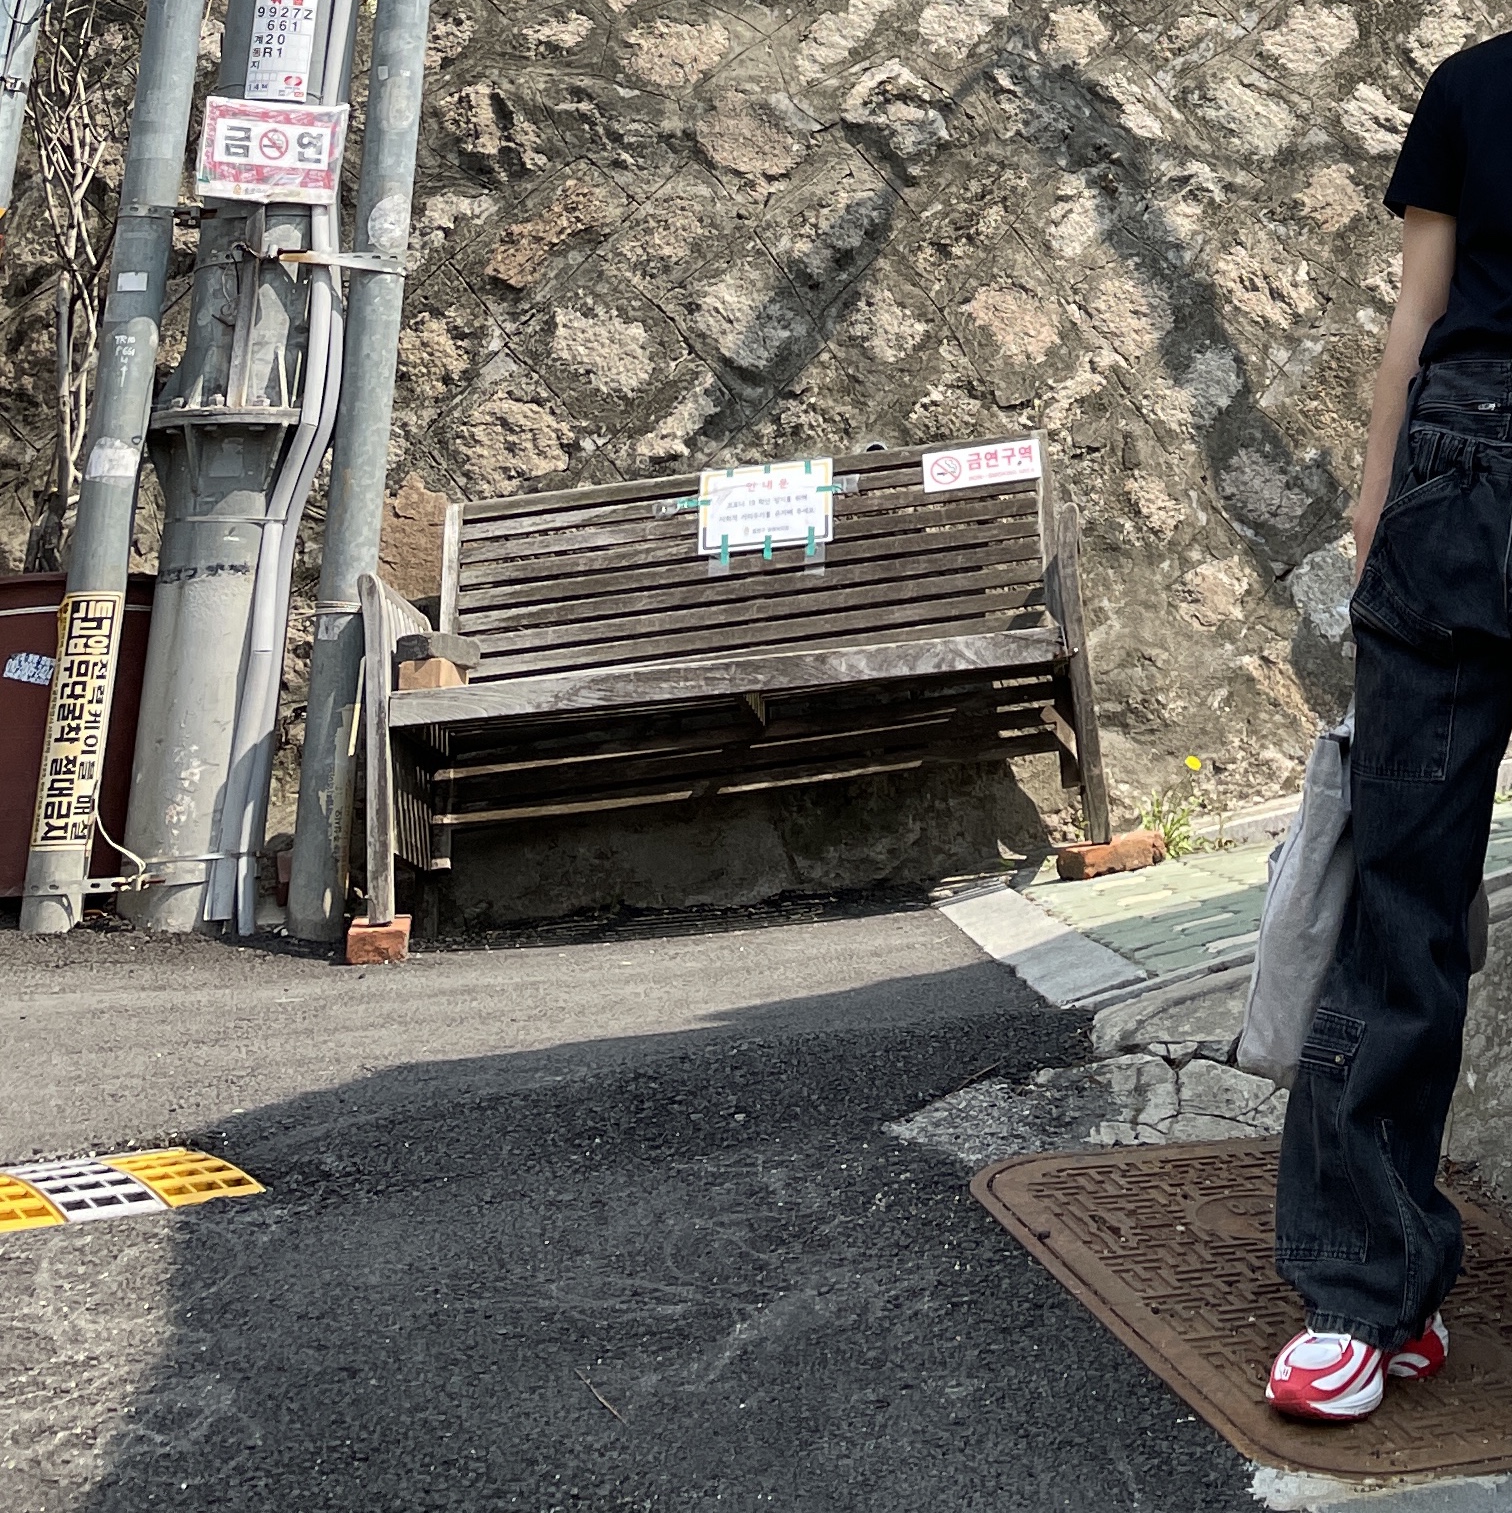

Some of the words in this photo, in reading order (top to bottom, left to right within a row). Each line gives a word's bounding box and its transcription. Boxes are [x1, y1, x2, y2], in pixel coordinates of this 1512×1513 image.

[966, 445, 1033, 471] 금연구역
[54, 660, 90, 744] 무단굴착
[41, 755, 78, 841] 절대금지
